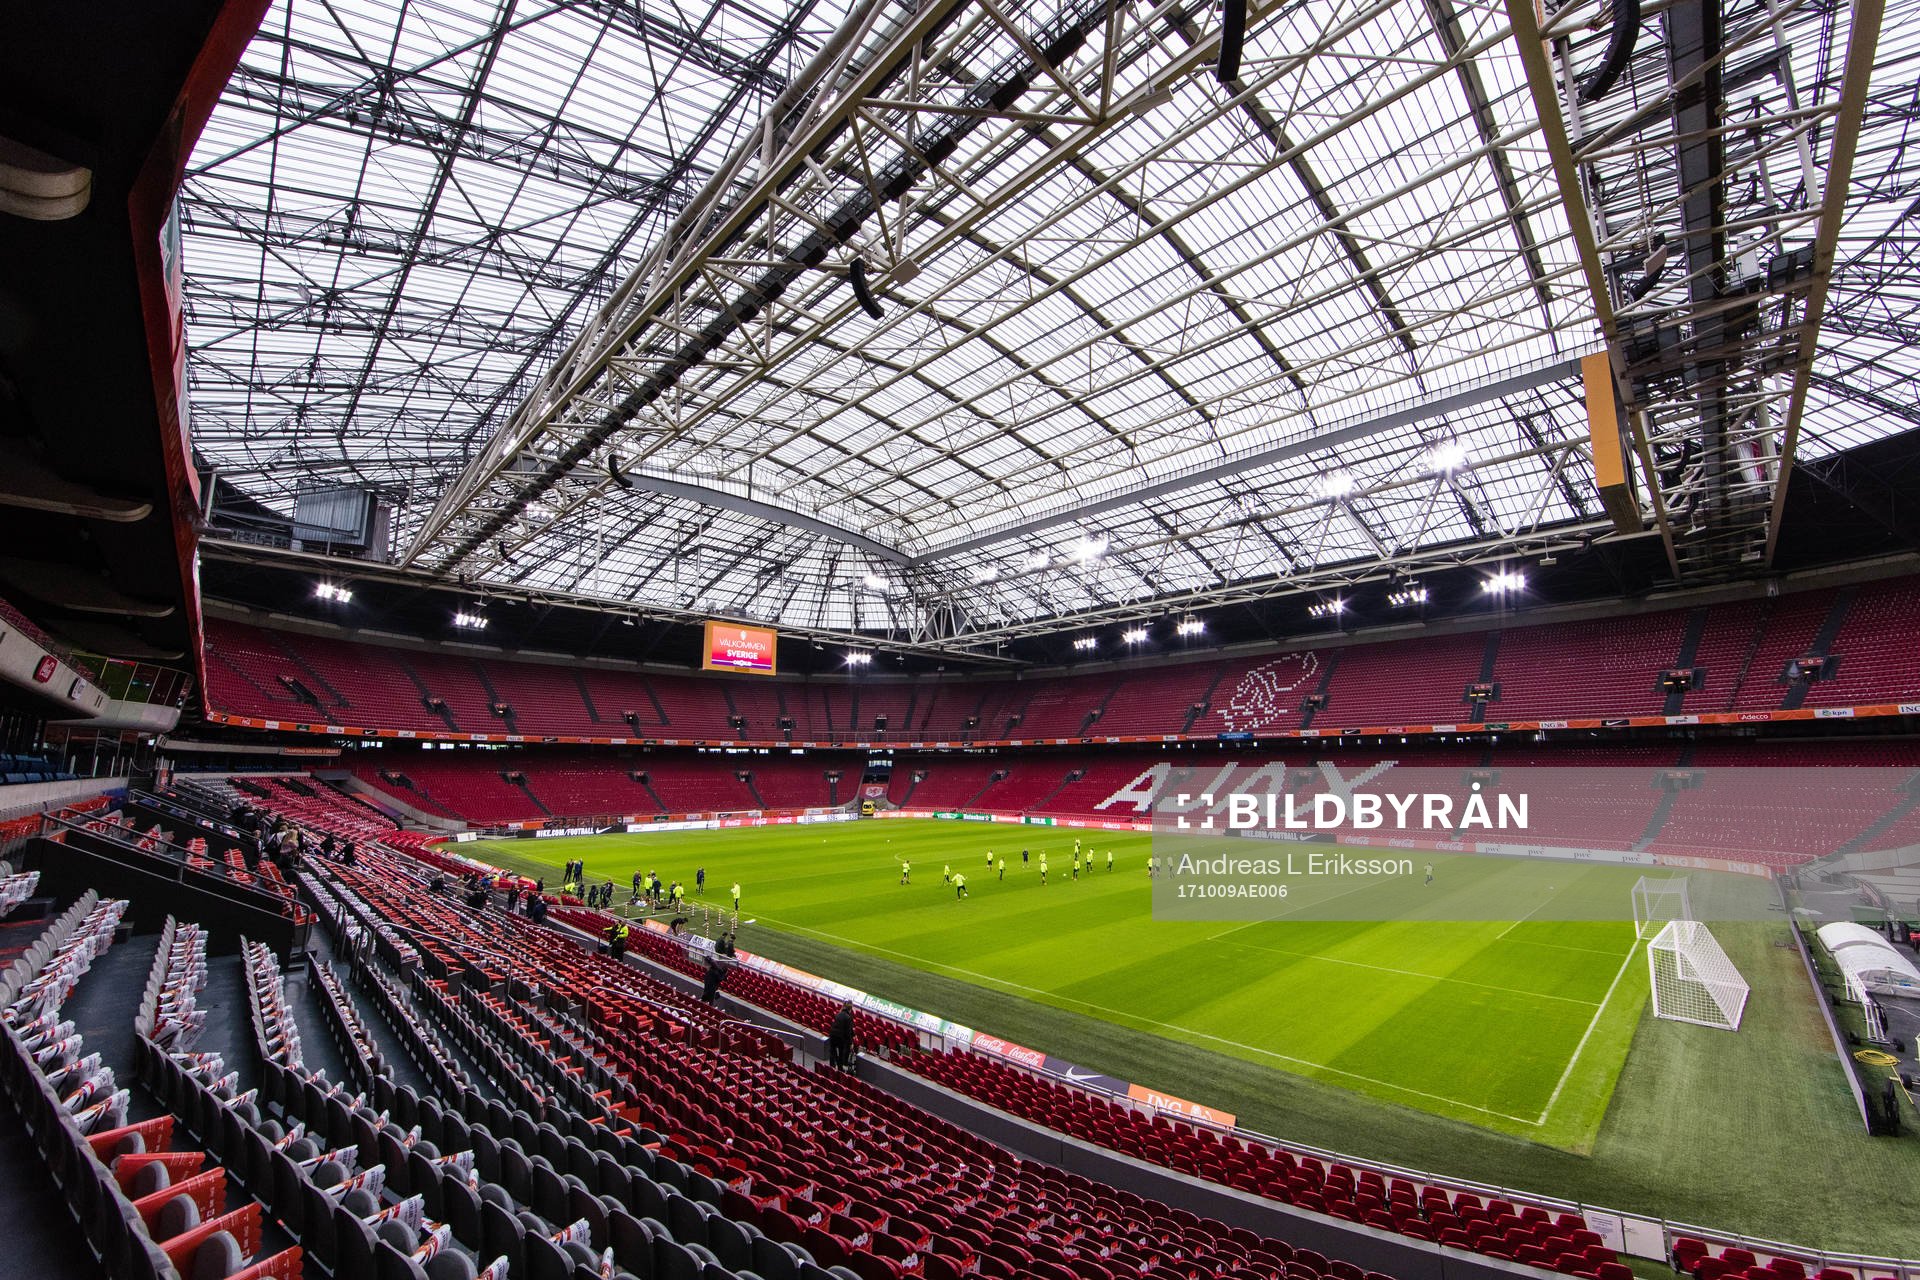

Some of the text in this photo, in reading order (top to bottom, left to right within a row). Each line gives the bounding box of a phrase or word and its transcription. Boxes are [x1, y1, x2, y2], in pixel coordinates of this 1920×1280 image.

[726, 649, 758, 660] SVERIGE
[1741, 713, 1769, 721] Adecco
[535, 827, 595, 838] NIKE.COM/FOOTBALL
[1240, 829, 1299, 841] NIKE.COM/FOOTBALL
[1663, 856, 1688, 867] ING
[1727, 862, 1750, 874] ING
[864, 994, 905, 1018] Heineken
[1146, 1092, 1182, 1114] ING
